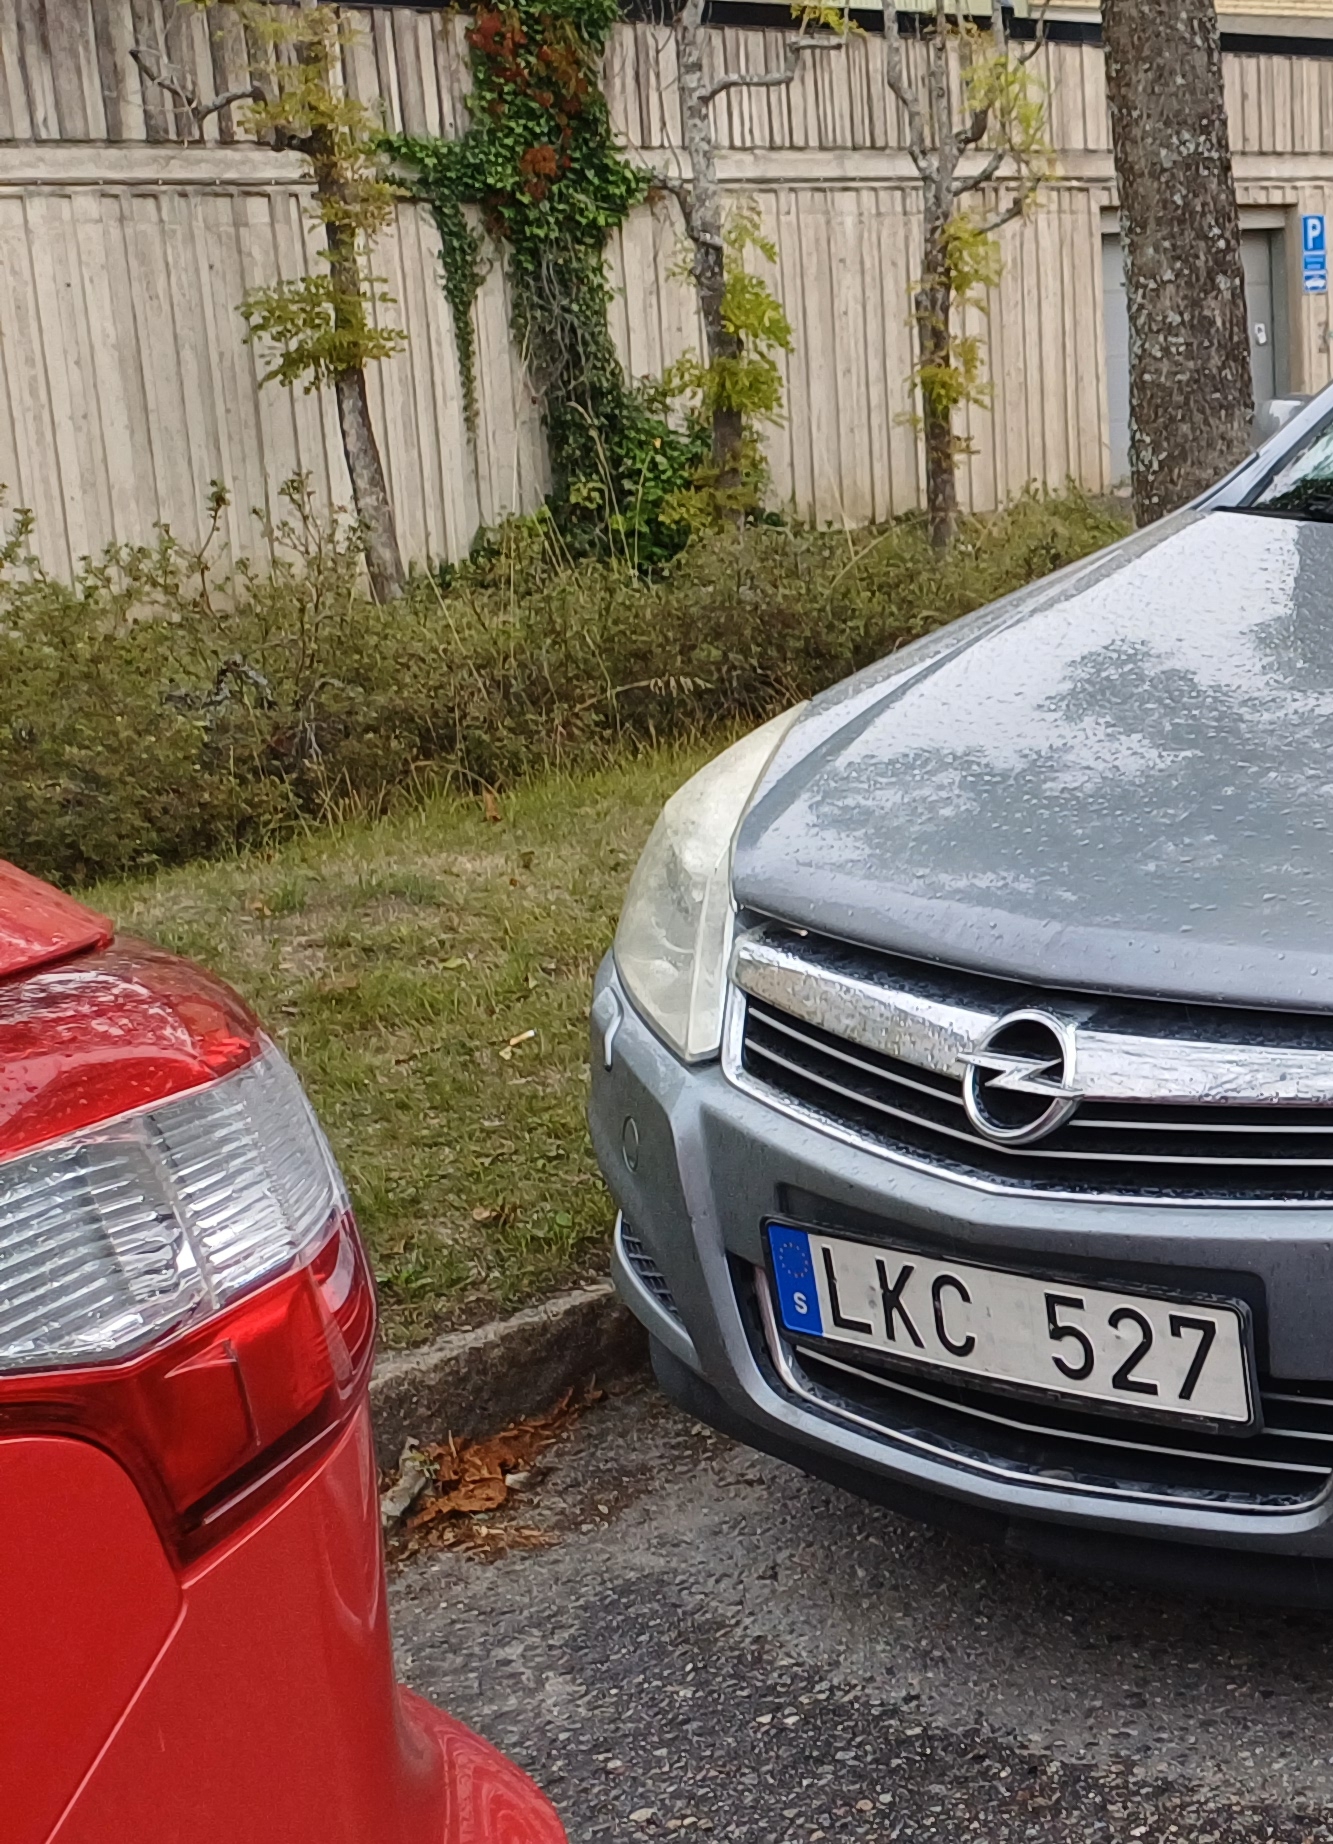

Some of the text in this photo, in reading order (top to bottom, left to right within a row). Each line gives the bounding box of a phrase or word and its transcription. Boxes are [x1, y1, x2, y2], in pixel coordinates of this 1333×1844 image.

[1307, 218, 1321, 250] P
[793, 1292, 809, 1315] S
[820, 1246, 1217, 1401] LKC 527
